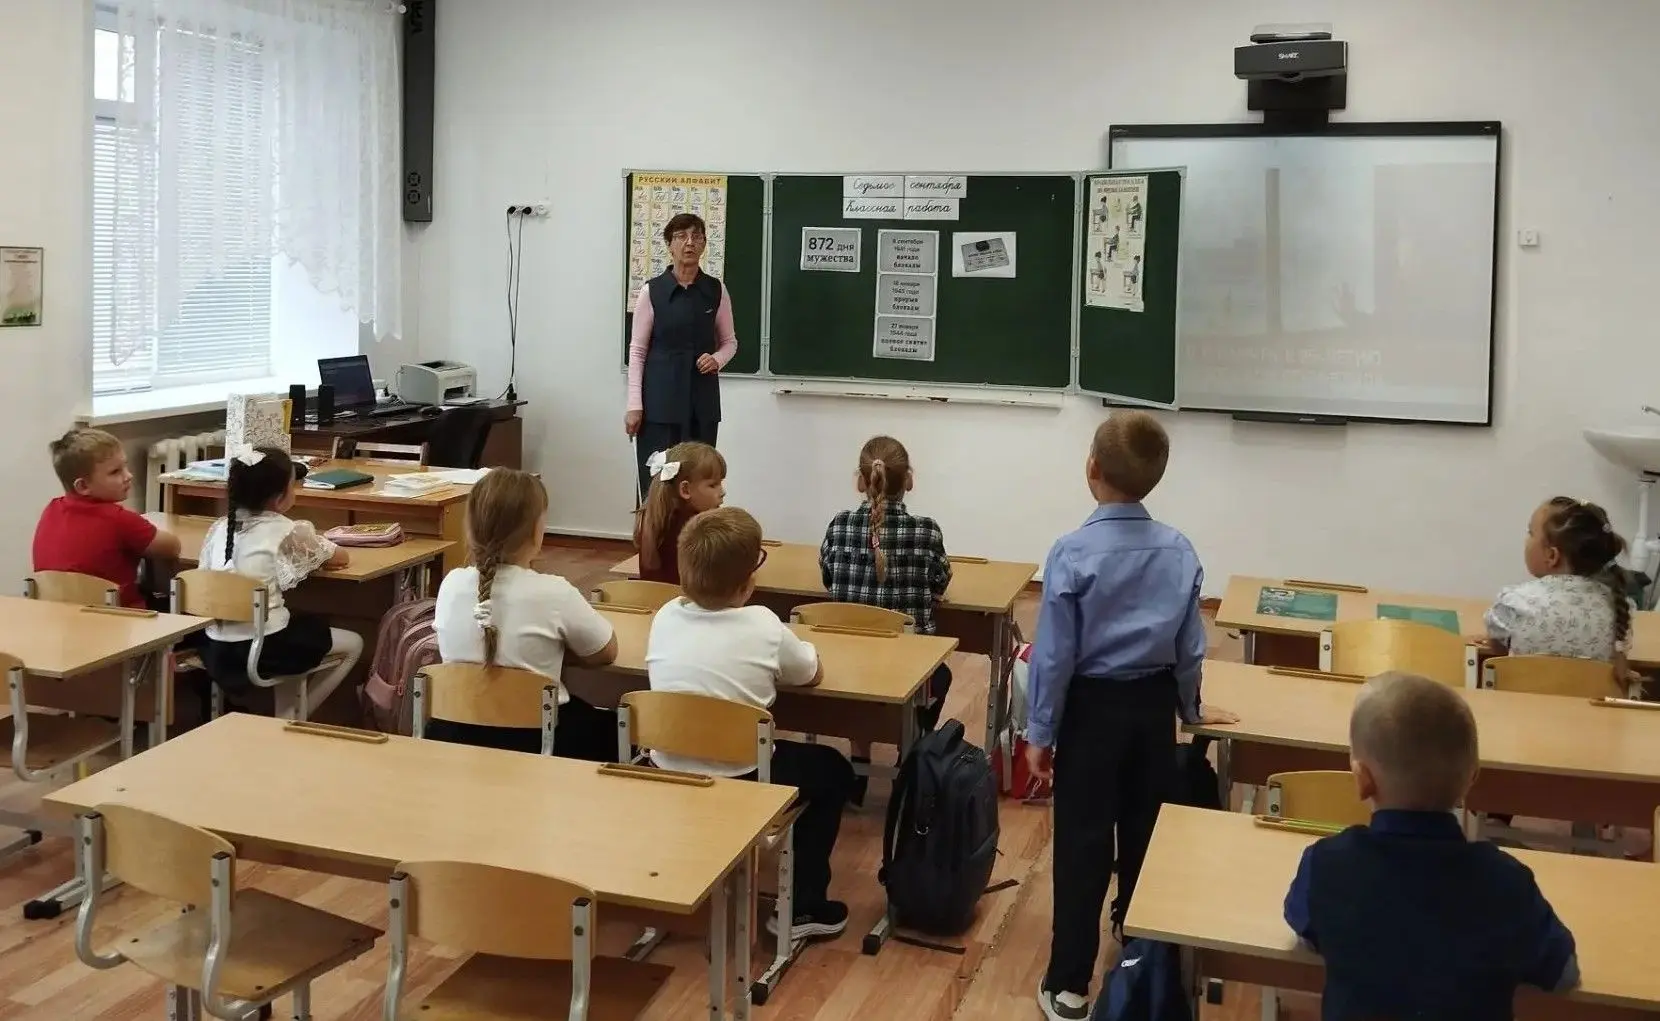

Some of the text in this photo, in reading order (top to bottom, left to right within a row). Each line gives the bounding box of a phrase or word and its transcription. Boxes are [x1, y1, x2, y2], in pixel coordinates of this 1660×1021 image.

[639, 176, 721, 185] РУССКИЙ АЛФАВИТ
[910, 177, 963, 195] сентября
[846, 200, 952, 217] Классная работа
[808, 237, 854, 252] 872 дня
[807, 255, 854, 265] мужества
[889, 345, 918, 353] блокады
